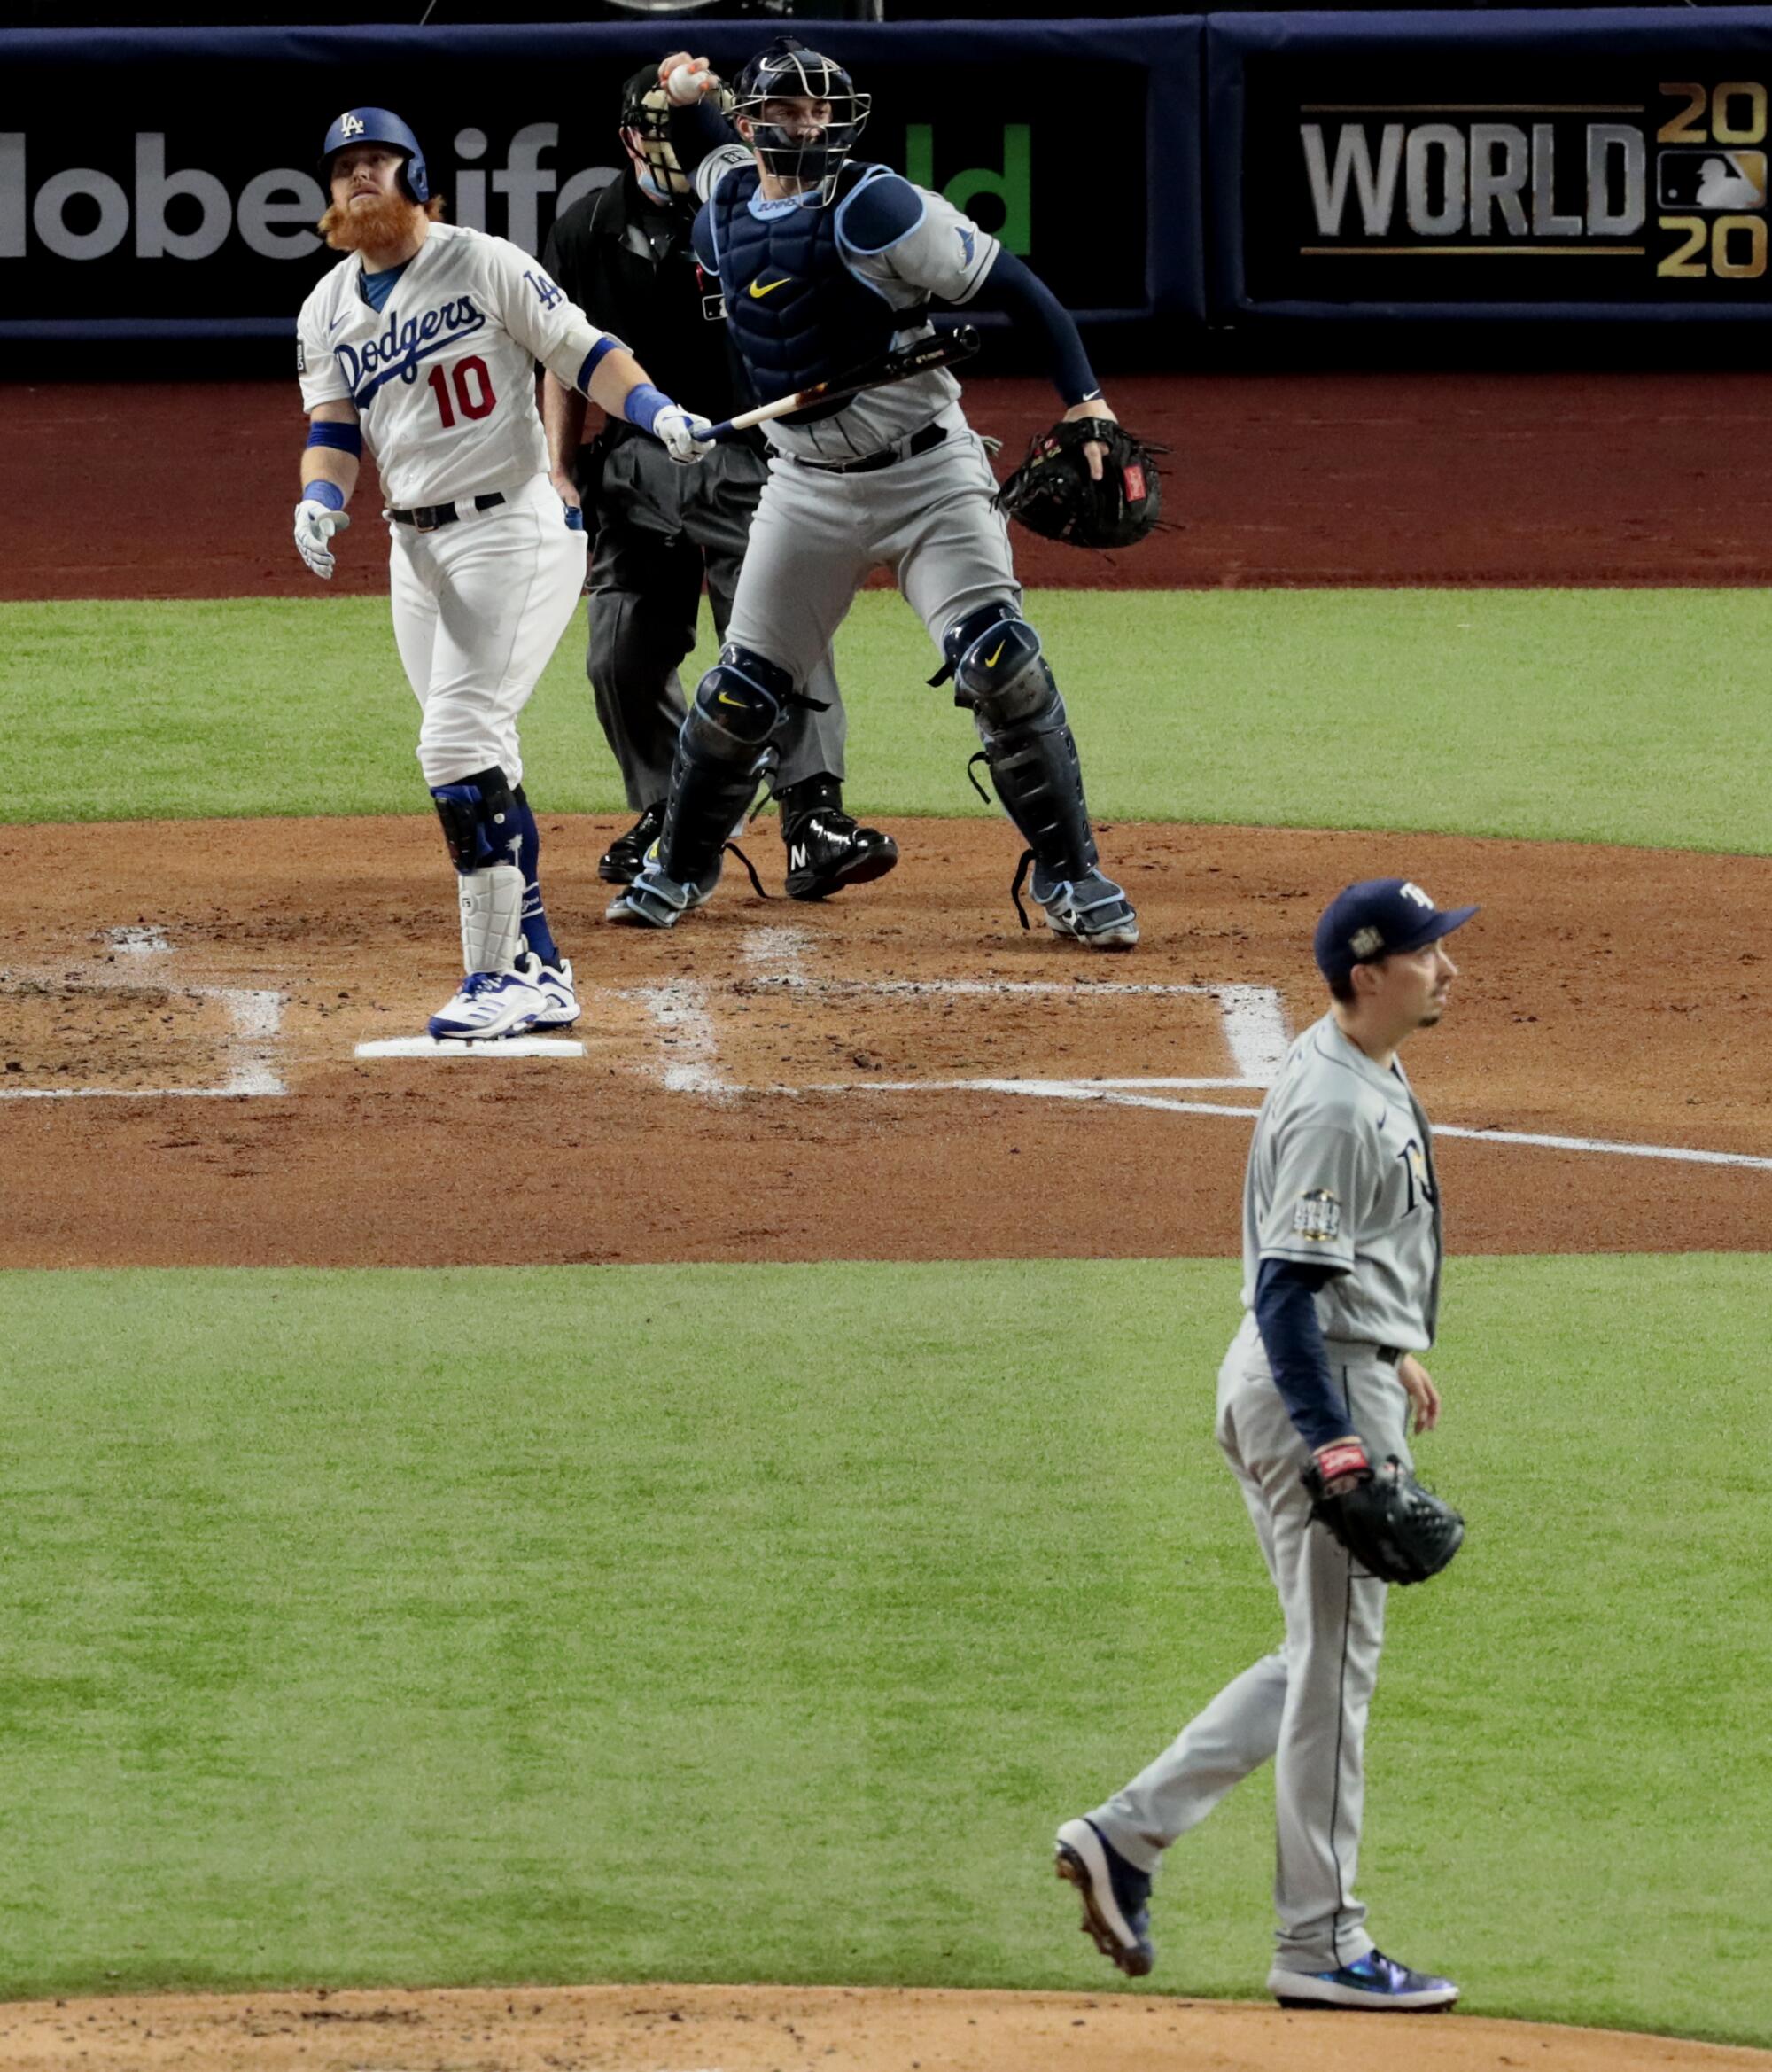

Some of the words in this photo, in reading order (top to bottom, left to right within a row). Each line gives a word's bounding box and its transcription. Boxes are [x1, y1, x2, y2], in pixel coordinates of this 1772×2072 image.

[340, 113, 364, 137] LA
[1657, 82, 1768, 144] 20
[1300, 123, 1646, 237] WORLD
[1657, 215, 1768, 278] 20
[524, 270, 563, 310] LA
[334, 296, 486, 395] Dodgers
[428, 355, 496, 428] 10
